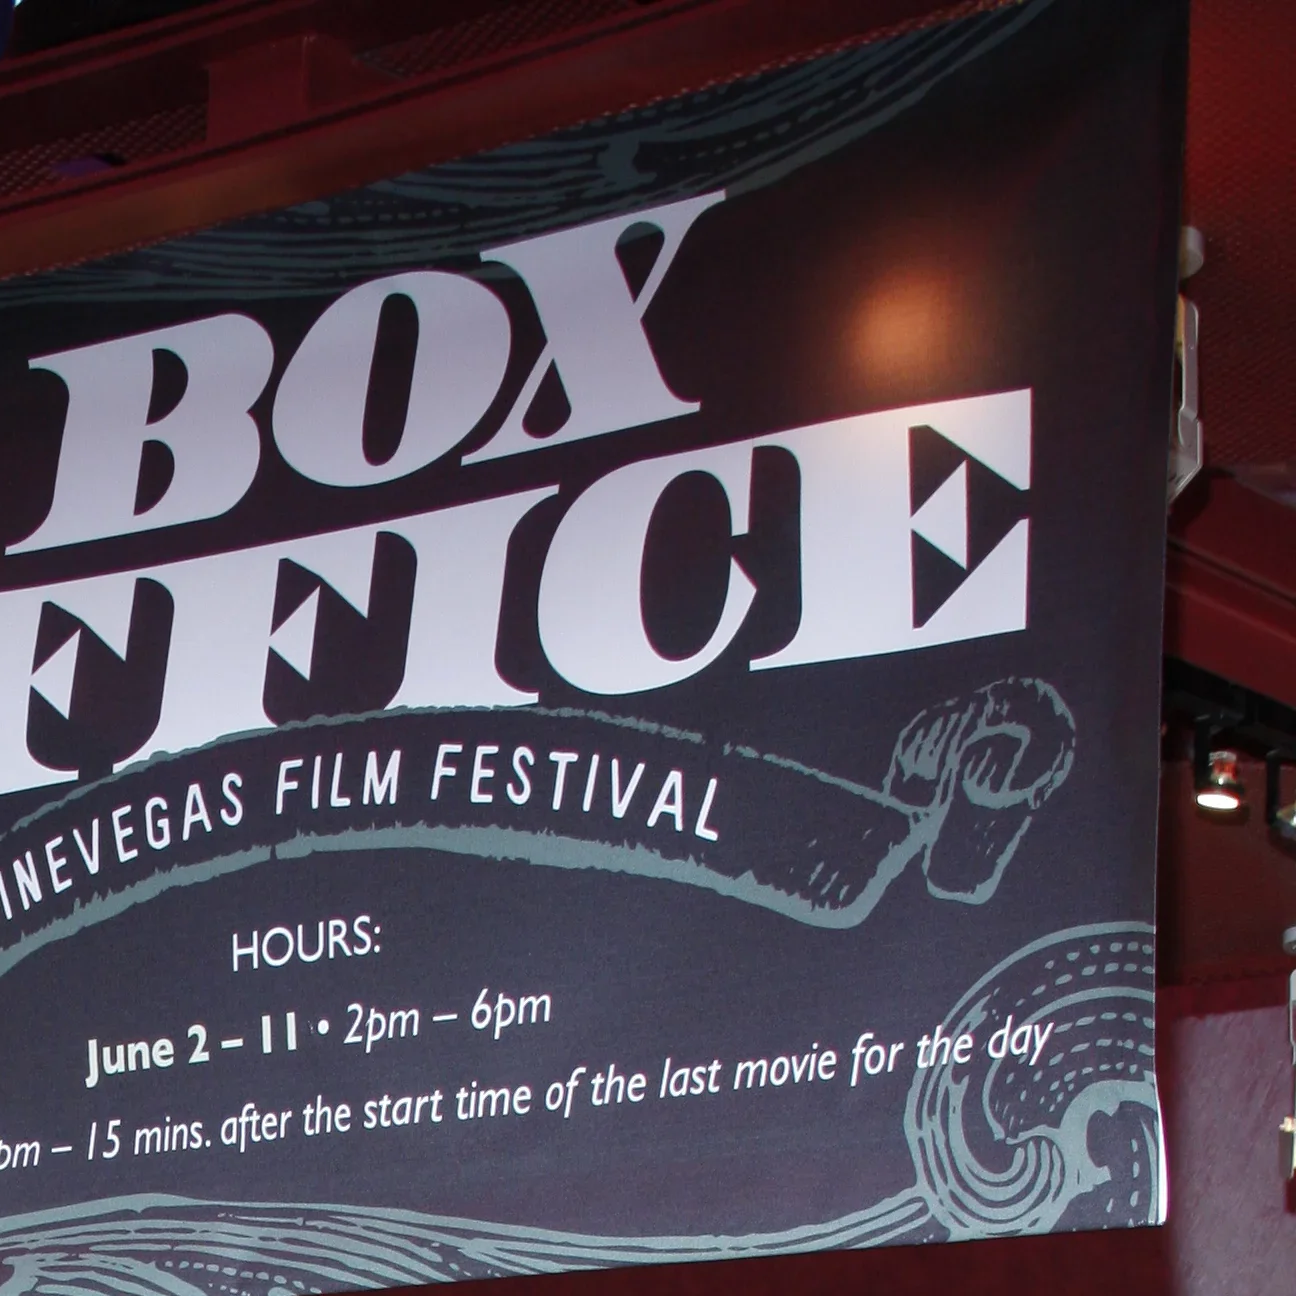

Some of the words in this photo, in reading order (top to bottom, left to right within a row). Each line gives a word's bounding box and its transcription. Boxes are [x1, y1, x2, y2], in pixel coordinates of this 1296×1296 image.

[4, 191, 725, 556] BOX
[275, 744, 401, 816] FILM
[430, 742, 721, 842] FESTIVAL
[231, 915, 382, 972] HOURS:
[84, 1036, 174, 1088] June
[187, 1024, 209, 1064] 2
[261, 1012, 297, 1054] 11
[344, 1002, 420, 1054] 2pm
[471, 988, 551, 1040] 6pm
[88, 1119, 120, 1160] 15
[134, 1115, 211, 1157] mins.
[221, 1103, 291, 1153] after
[303, 1095, 351, 1137] the
[364, 1088, 443, 1130] start
[456, 1081, 530, 1121] time
[545, 1066, 586, 1118] of
[590, 1063, 646, 1106] the
[659, 1057, 721, 1099] last
[733, 1042, 837, 1090] movie
[850, 1032, 905, 1087] for
[916, 1024, 974, 1069] the
[987, 1014, 1054, 1066] day
